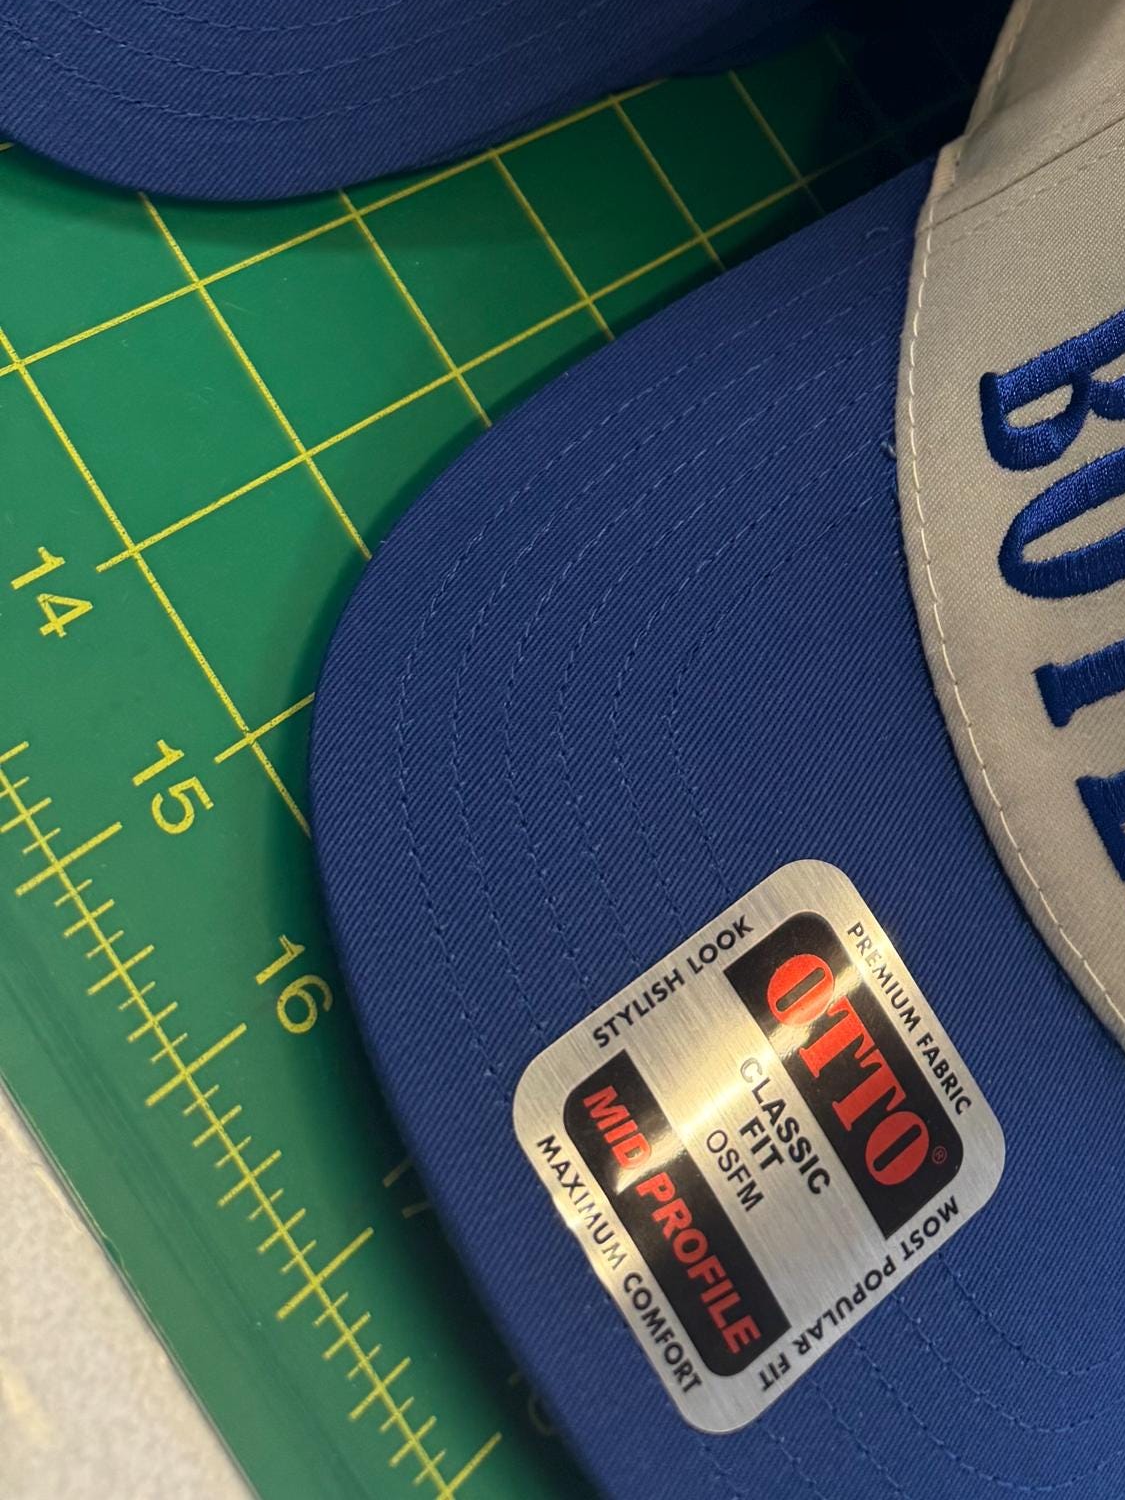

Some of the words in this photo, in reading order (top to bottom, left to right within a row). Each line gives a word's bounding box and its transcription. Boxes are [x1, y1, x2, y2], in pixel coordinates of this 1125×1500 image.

[11, 546, 93, 638] 14
[132, 739, 214, 835] 15
[255, 934, 333, 1035] 16
[592, 967, 686, 1049] STYLISH
[686, 913, 755, 975] LOOK
[846, 920, 923, 1034] PREMIUM
[916, 1031, 973, 1116] FABRIC
[705, 1128, 766, 1213] OSFM
[738, 1115, 784, 1171] FIT
[739, 1056, 831, 1195] CLASSIC
[535, 1133, 629, 1271] MAXIMUM
[622, 1271, 703, 1393] COMFORT
[582, 1084, 653, 1171] MID
[635, 1170, 762, 1355] PROFILE
[899, 1194, 961, 1263] MOST
[791, 1254, 899, 1357] POPULAR
[758, 1350, 793, 1393] FIT
